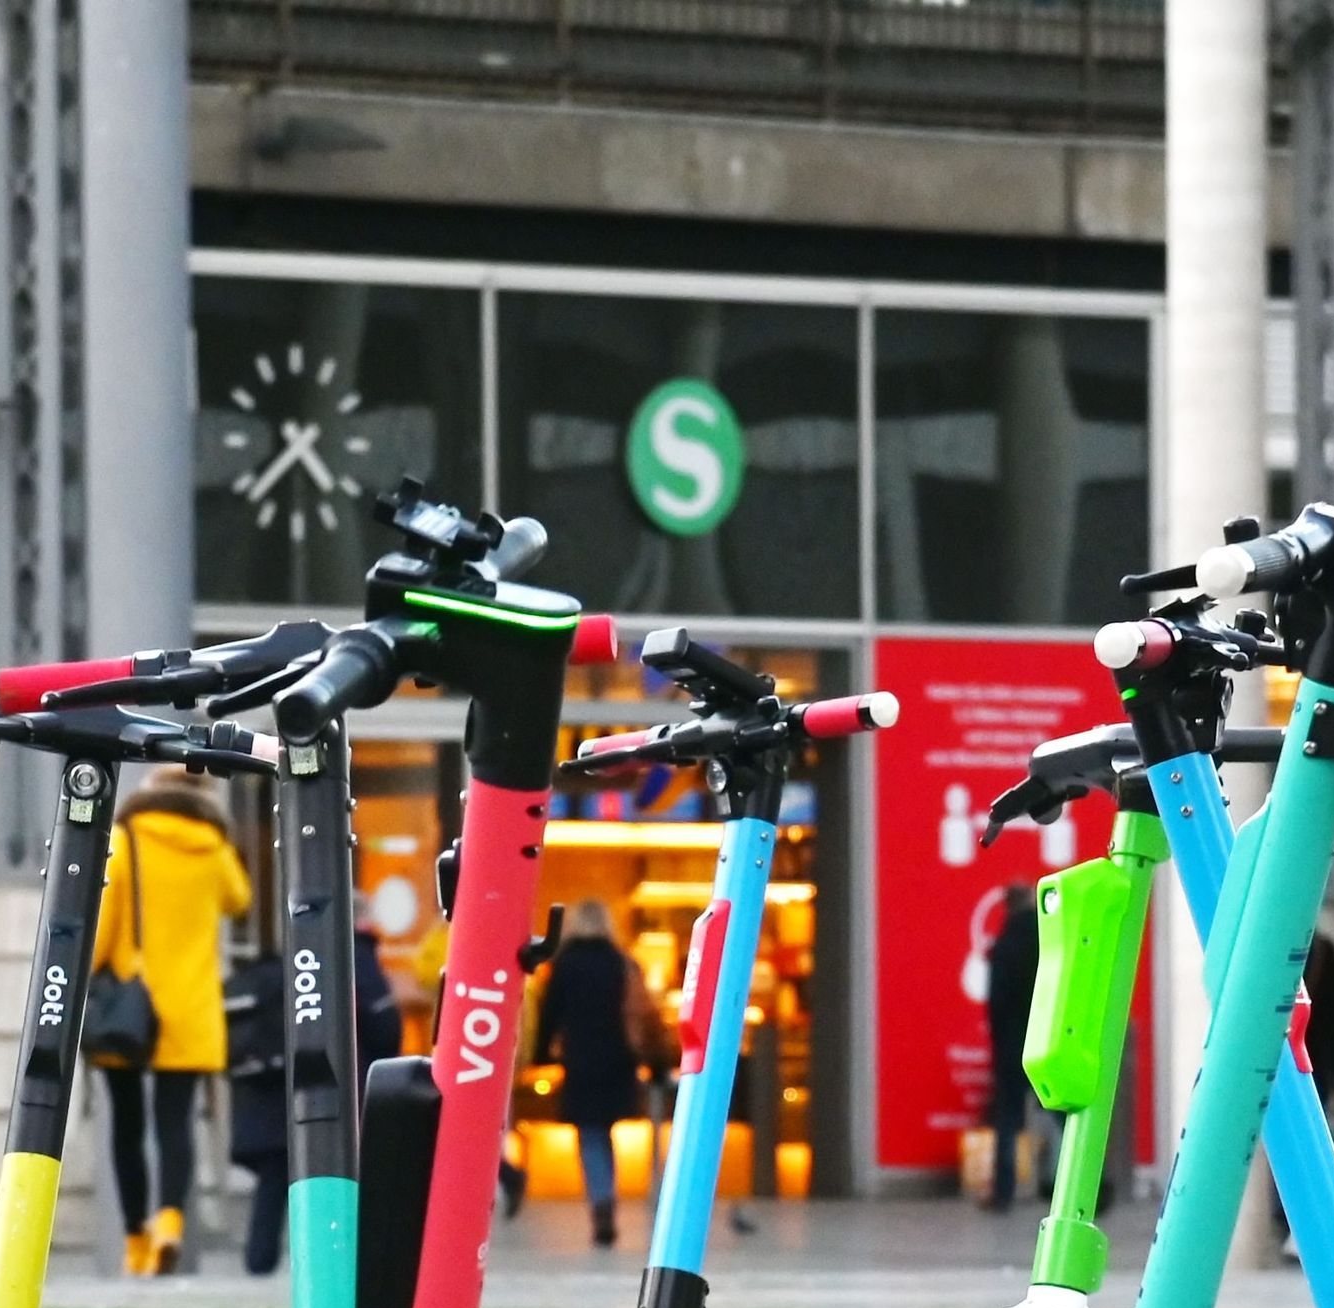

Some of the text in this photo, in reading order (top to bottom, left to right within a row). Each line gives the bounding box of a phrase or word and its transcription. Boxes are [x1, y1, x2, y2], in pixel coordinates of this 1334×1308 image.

[651, 396, 725, 520] S
[39, 965, 68, 1026] dott
[294, 949, 322, 1024] dott
[455, 970, 509, 1084] voi.
